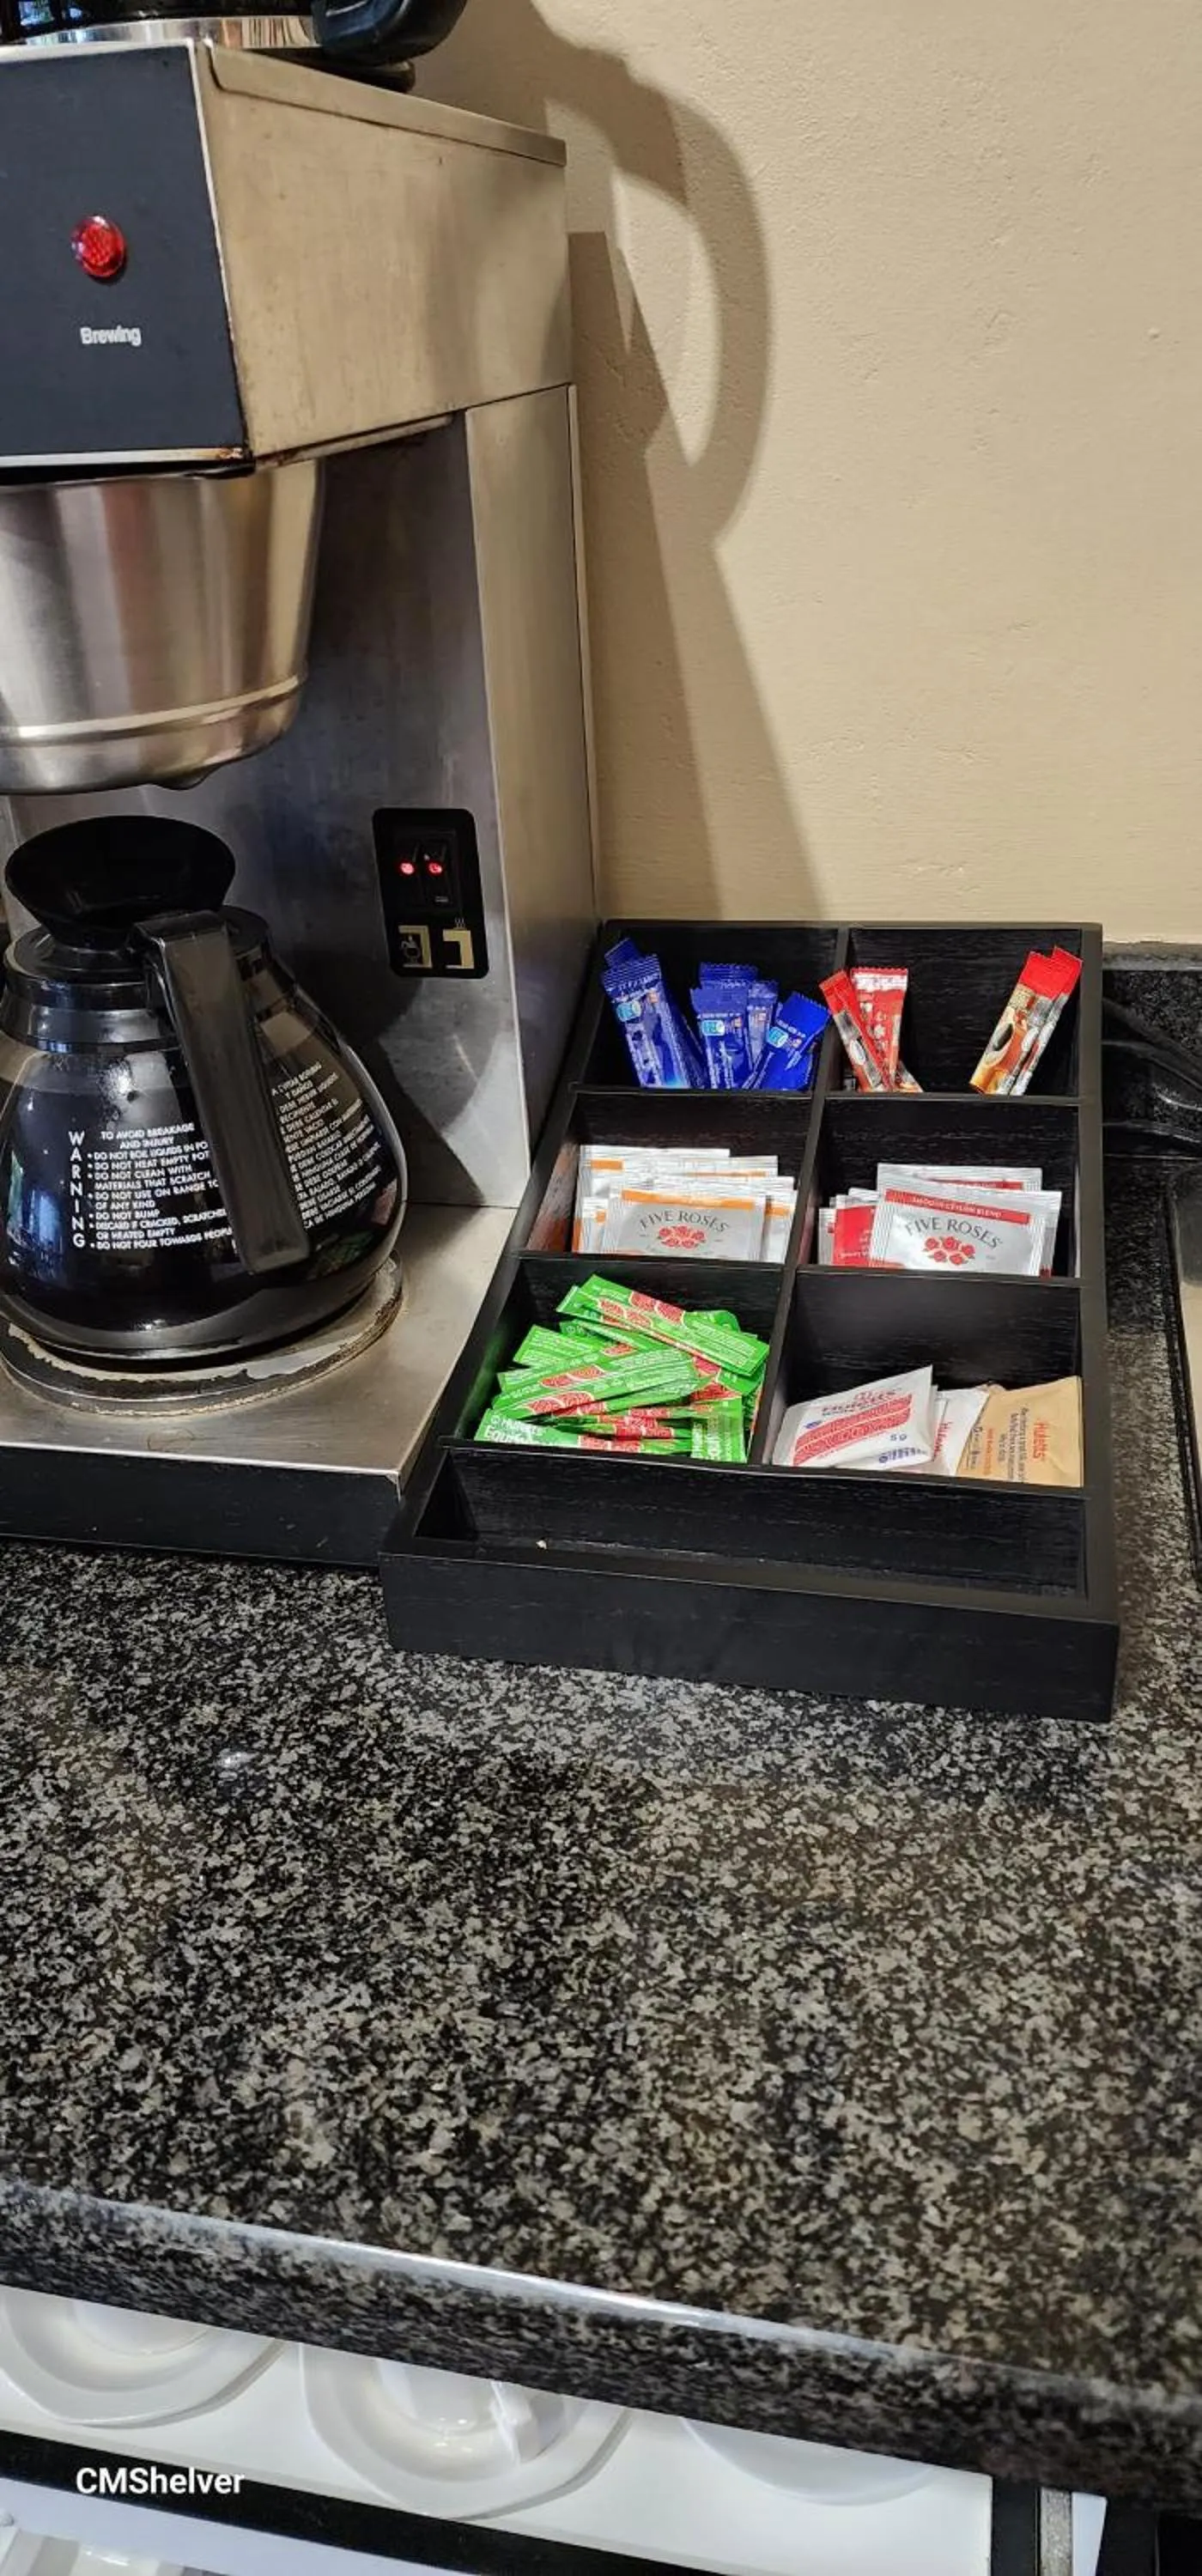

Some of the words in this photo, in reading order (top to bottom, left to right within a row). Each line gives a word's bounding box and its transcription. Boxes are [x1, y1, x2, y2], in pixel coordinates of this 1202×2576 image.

[80, 325, 143, 346] Brewing
[100, 1131, 113, 1140] TO
[116, 1128, 145, 1139] AVOID
[147, 1122, 195, 1138] BREAKAGE
[94, 1151, 108, 1161] DO
[109, 1150, 128, 1160] NOT
[130, 1148, 149, 1159] BOIL
[149, 1145, 183, 1157] LIQUIDS
[184, 1143, 194, 1152] IN
[195, 1140, 209, 1151] PO
[119, 1139, 141, 1150] AND
[142, 1136, 174, 1149] INJURY
[94, 1161, 109, 1170] DO
[111, 1159, 131, 1170] NOT
[134, 1156, 158, 1168] HEAT
[161, 1152, 190, 1165] EMPTY
[191, 1150, 210, 1161] POT
[94, 1171, 109, 1181] DO
[111, 1170, 131, 1180] NOT
[133, 1167, 166, 1179] CLEAN
[167, 1163, 192, 1176] WITH
[94, 1178, 142, 1191] MATERIALS
[144, 1176, 167, 1188] THAT
[170, 1170, 211, 1184] SCRATCH
[68, 1131, 85, 1249] WARNING
[94, 1191, 109, 1200] DO
[111, 1190, 133, 1200] NOT
[135, 1188, 152, 1199] USE
[155, 1187, 171, 1198] ON
[173, 1182, 206, 1195] RANGE
[95, 1200, 108, 1211] OF
[110, 1200, 130, 1210] ANY
[132, 1199, 155, 1209] KIND
[95, 1211, 110, 1220] DO
[112, 1210, 132, 1220] NOT
[134, 1208, 161, 1219] BUMP
[976, 1207, 1002, 1218] BLEND
[95, 1219, 130, 1230] DISCARD
[131, 1219, 138, 1229] IF
[139, 1216, 181, 1230] CRACKED,
[182, 1208, 228, 1223] SCRATCHE
[640, 1210, 675, 1230] FIVE
[677, 1209, 730, 1233] ROSES
[95, 1230, 109, 1240] OR
[111, 1229, 145, 1240] HEATED
[147, 1226, 176, 1238] EMPTY
[95, 1241, 111, 1250] DO
[112, 1239, 133, 1249] NOT
[133, 1238, 159, 1249] POUR
[159, 1233, 203, 1247] TOWARDS
[203, 1226, 233, 1240] PEOPL
[905, 1217, 942, 1236] FIVE
[947, 1218, 1003, 1249] ROSES
